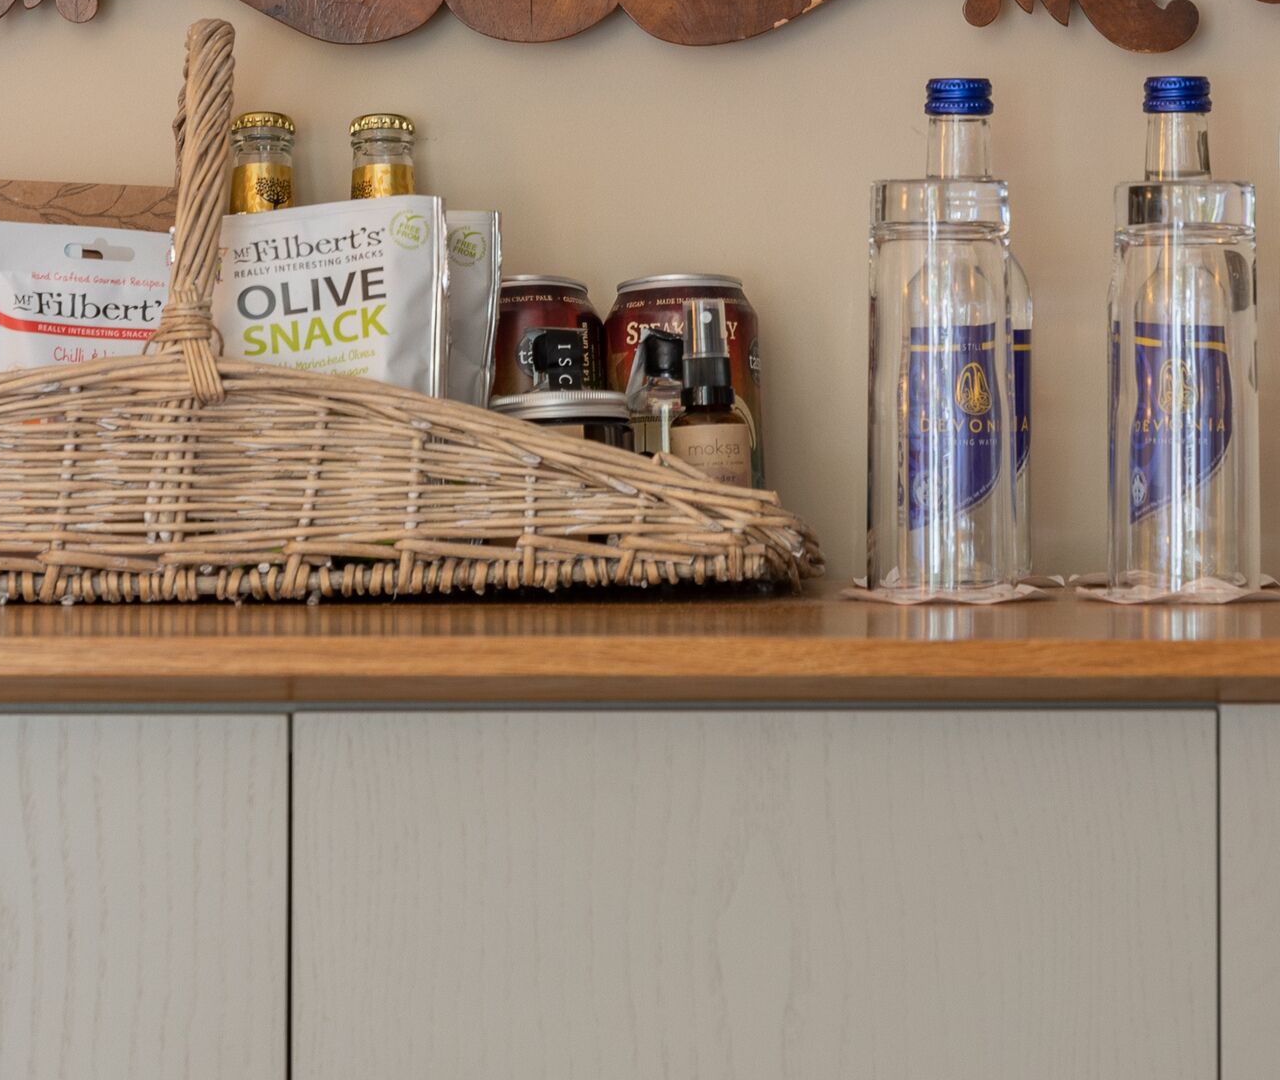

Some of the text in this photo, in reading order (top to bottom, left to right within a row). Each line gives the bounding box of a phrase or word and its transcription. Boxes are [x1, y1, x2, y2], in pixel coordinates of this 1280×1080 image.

[249, 226, 382, 264] Filbert's
[233, 249, 384, 280] REALLY INTERESTING SNACKS
[53, 271, 91, 285] Crafted
[237, 266, 387, 321] OLIVE
[511, 295, 535, 304] CRAFT
[656, 297, 675, 306] MADE
[32, 291, 164, 323] Filbert'
[37, 323, 66, 334] REALLY
[67, 326, 120, 337] INTERESTING
[242, 303, 389, 357] SNACK
[53, 345, 85, 363] Chilli
[961, 343, 982, 352] STILL
